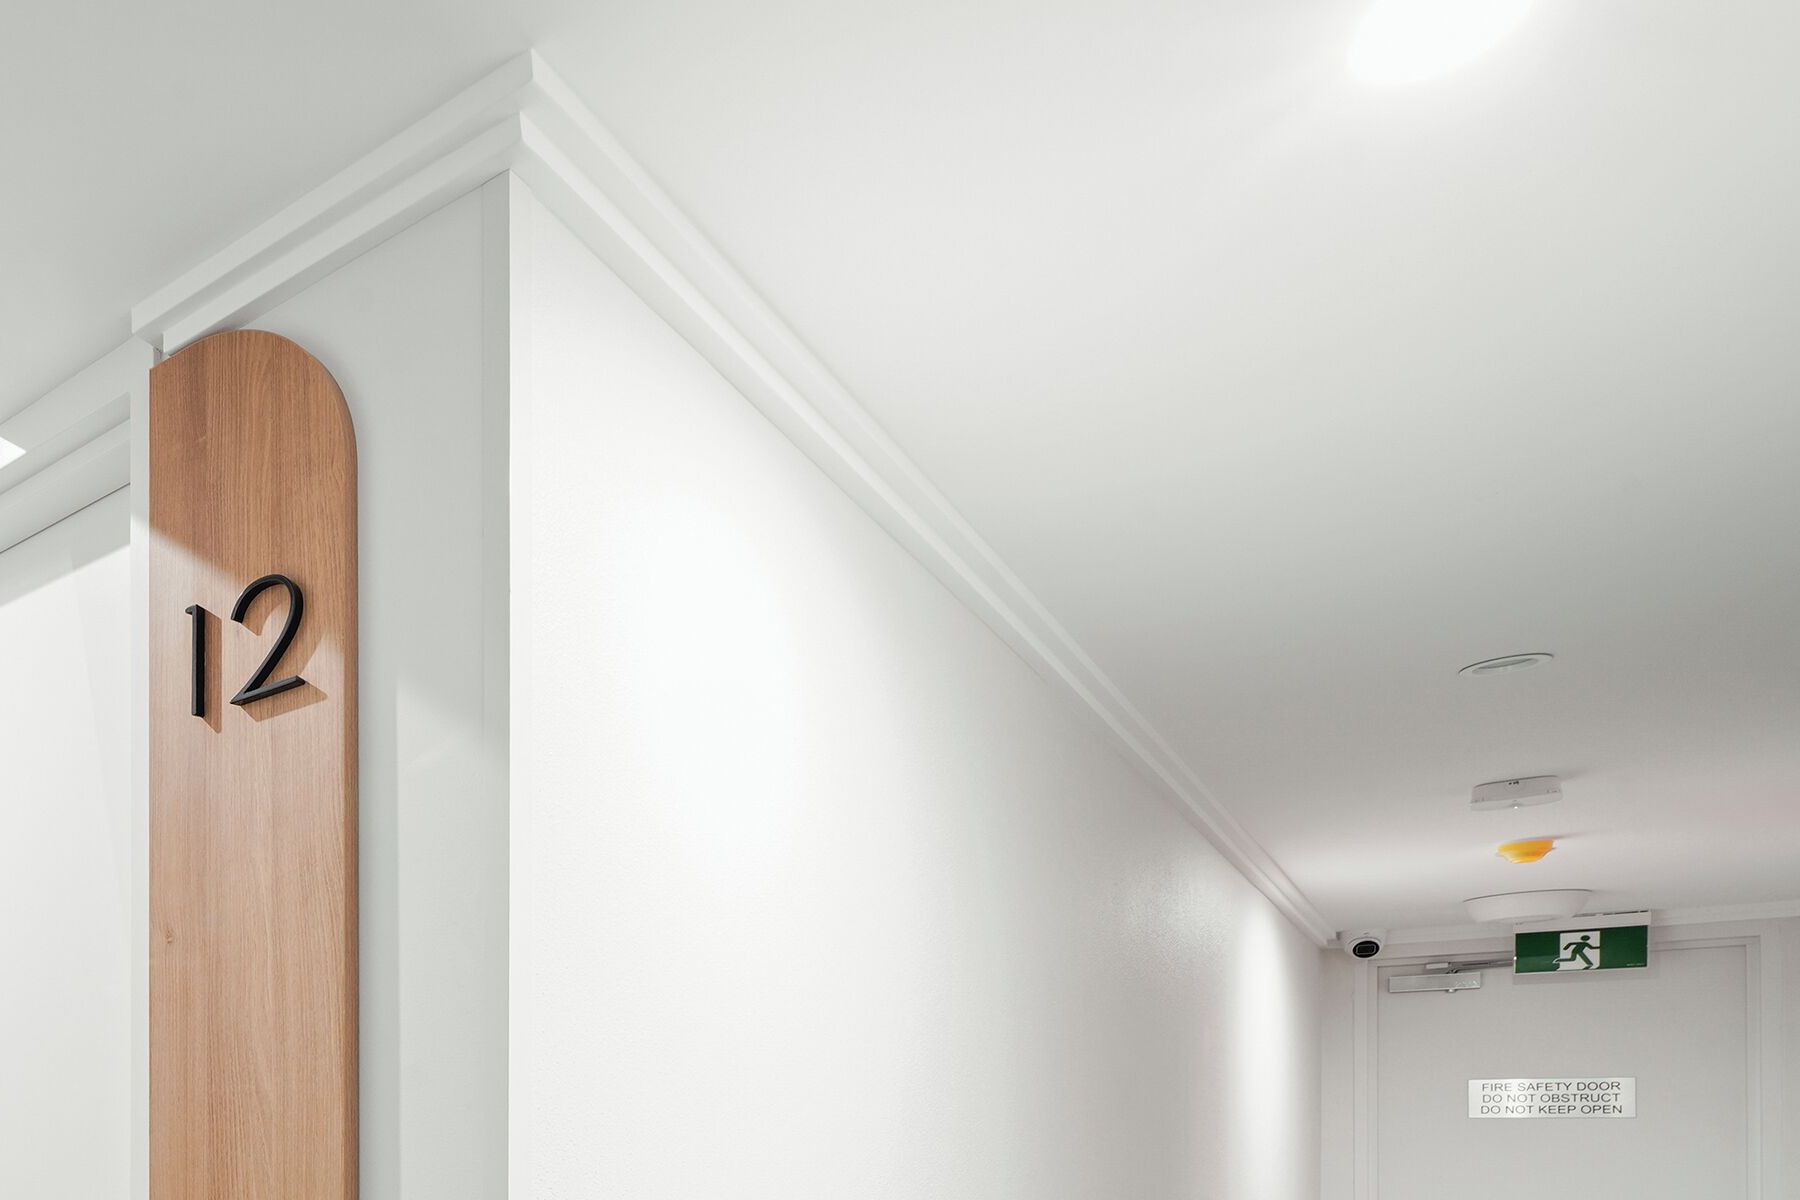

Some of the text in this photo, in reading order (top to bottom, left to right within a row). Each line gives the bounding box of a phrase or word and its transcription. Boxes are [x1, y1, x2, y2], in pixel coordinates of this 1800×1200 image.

[185, 573, 306, 718] 12
[1482, 1081, 1621, 1092] FIRE SAFETY DOOR
[1482, 1092, 1621, 1104] DO NOT OBSTRUCT
[1480, 1104, 1623, 1115] DO NOT KEEP OPEN
